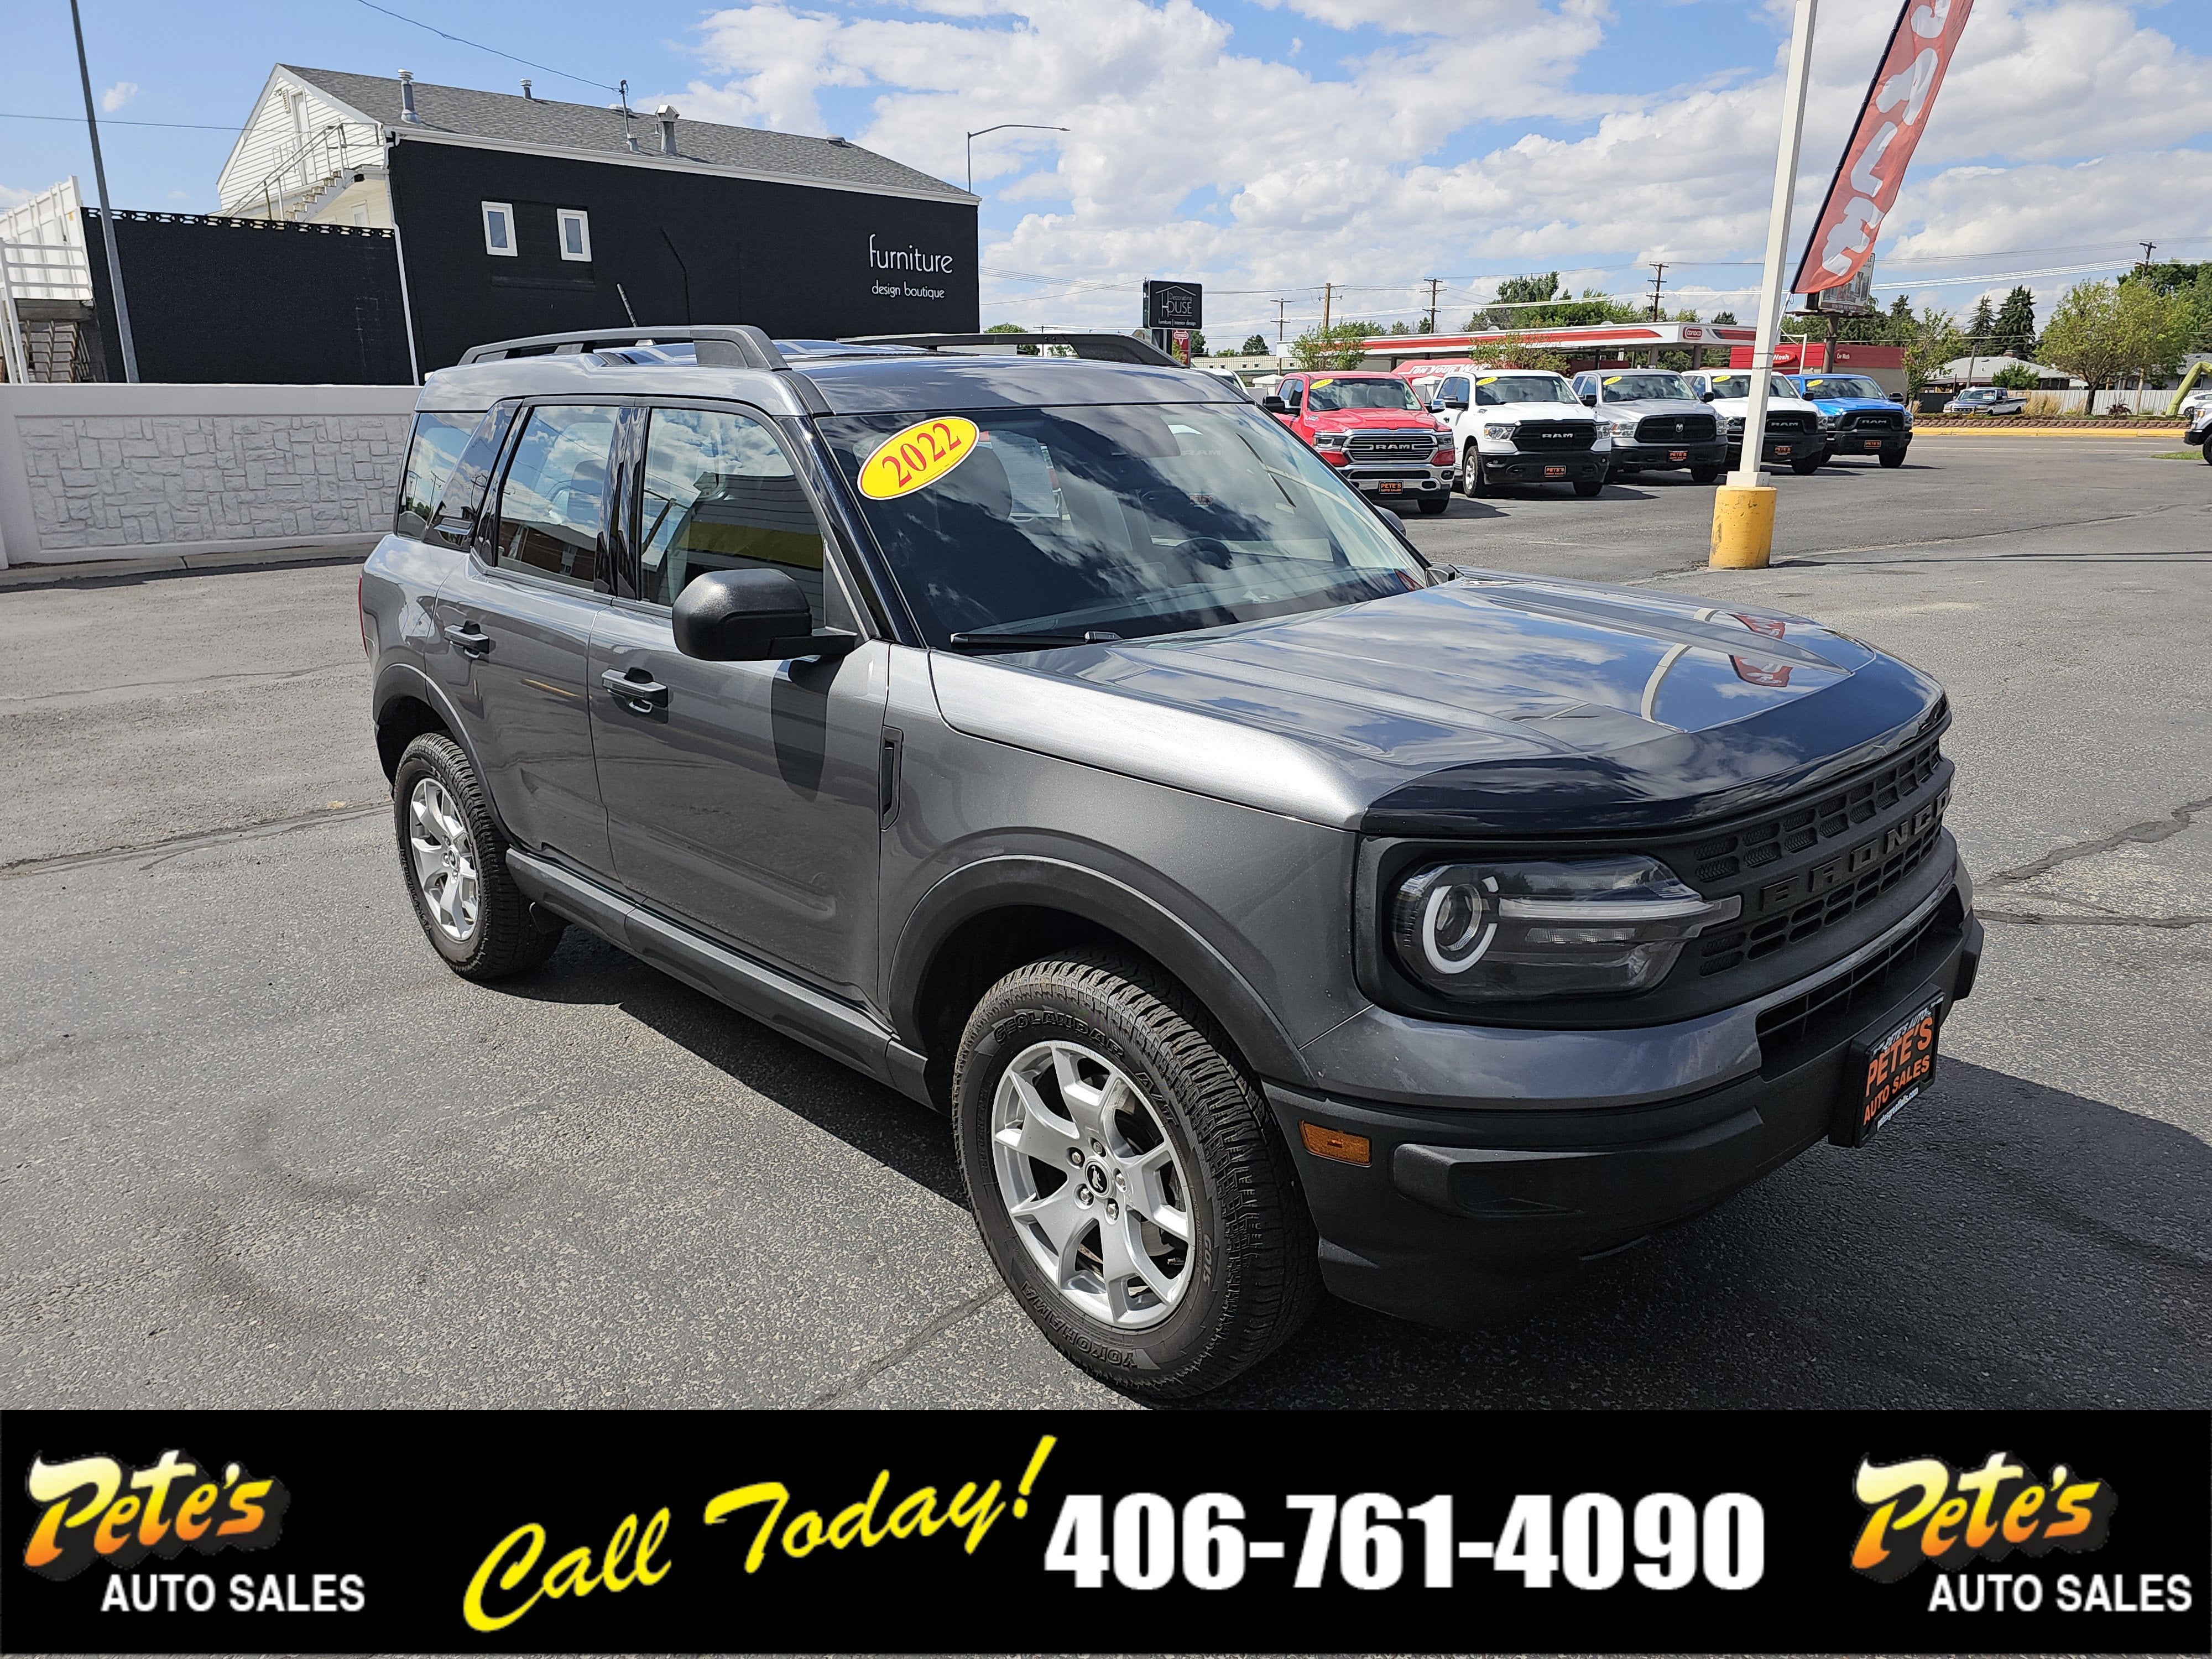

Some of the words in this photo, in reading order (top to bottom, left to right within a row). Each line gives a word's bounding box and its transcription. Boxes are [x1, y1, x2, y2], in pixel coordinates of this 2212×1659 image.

[869, 233, 953, 274] furniture
[872, 279, 901, 298] design
[904, 281, 946, 300] boutique
[1161, 290, 1193, 318] HOUSE
[882, 423, 962, 488] 2022
[1761, 786, 1950, 912] BRONCO
[1863, 1083, 1890, 1127] AUTO
[1892, 1055, 1931, 1095] SALES
[1865, 1016, 1934, 1098] PETE'S
[1019, 1280, 1139, 1372] YOKOHAMA
